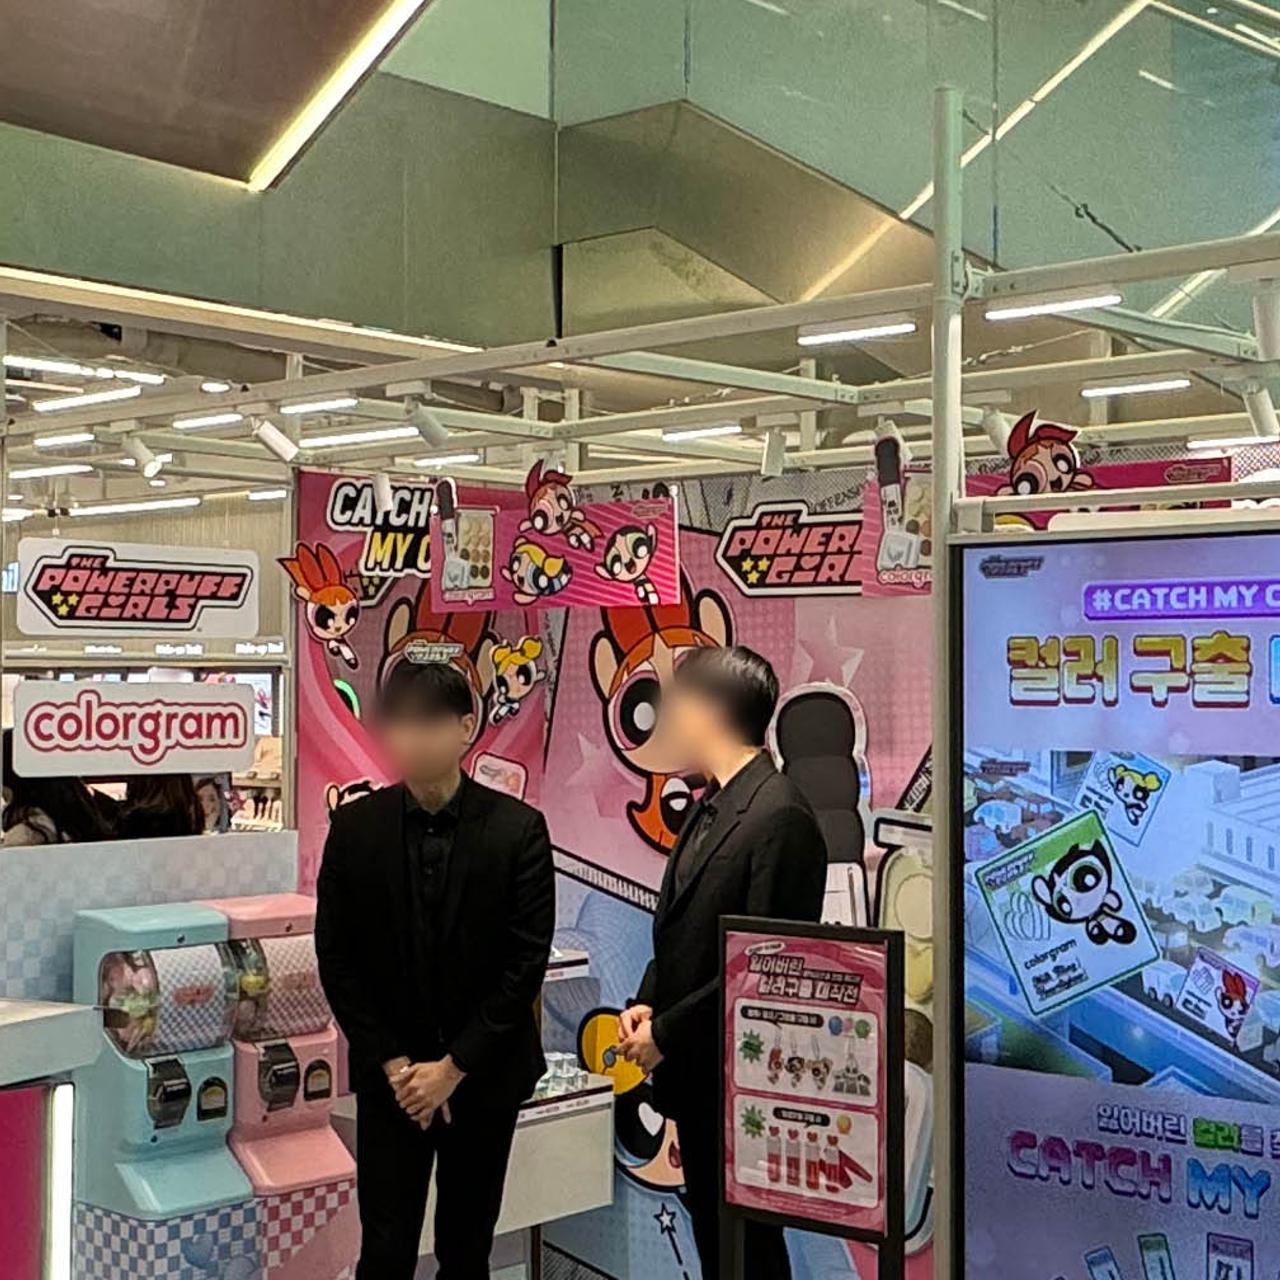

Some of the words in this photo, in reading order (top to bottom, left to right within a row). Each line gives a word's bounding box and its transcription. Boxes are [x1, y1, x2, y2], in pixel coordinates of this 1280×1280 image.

[70, 556, 104, 568] THE
[367, 532, 410, 570] MY
[37, 566, 247, 598] POWERPUFF
[1093, 586, 1207, 612] #CATCH
[1213, 585, 1259, 609] MY
[76, 594, 196, 620] GIRLS
[1006, 633, 1119, 707] 컬러
[1130, 630, 1253, 708] 구출
[32, 695, 240, 752] colorgram
[1097, 1105, 1187, 1142] 잃어버린
[1006, 1130, 1173, 1203] CATCH
[1186, 1158, 1271, 1218] MY
